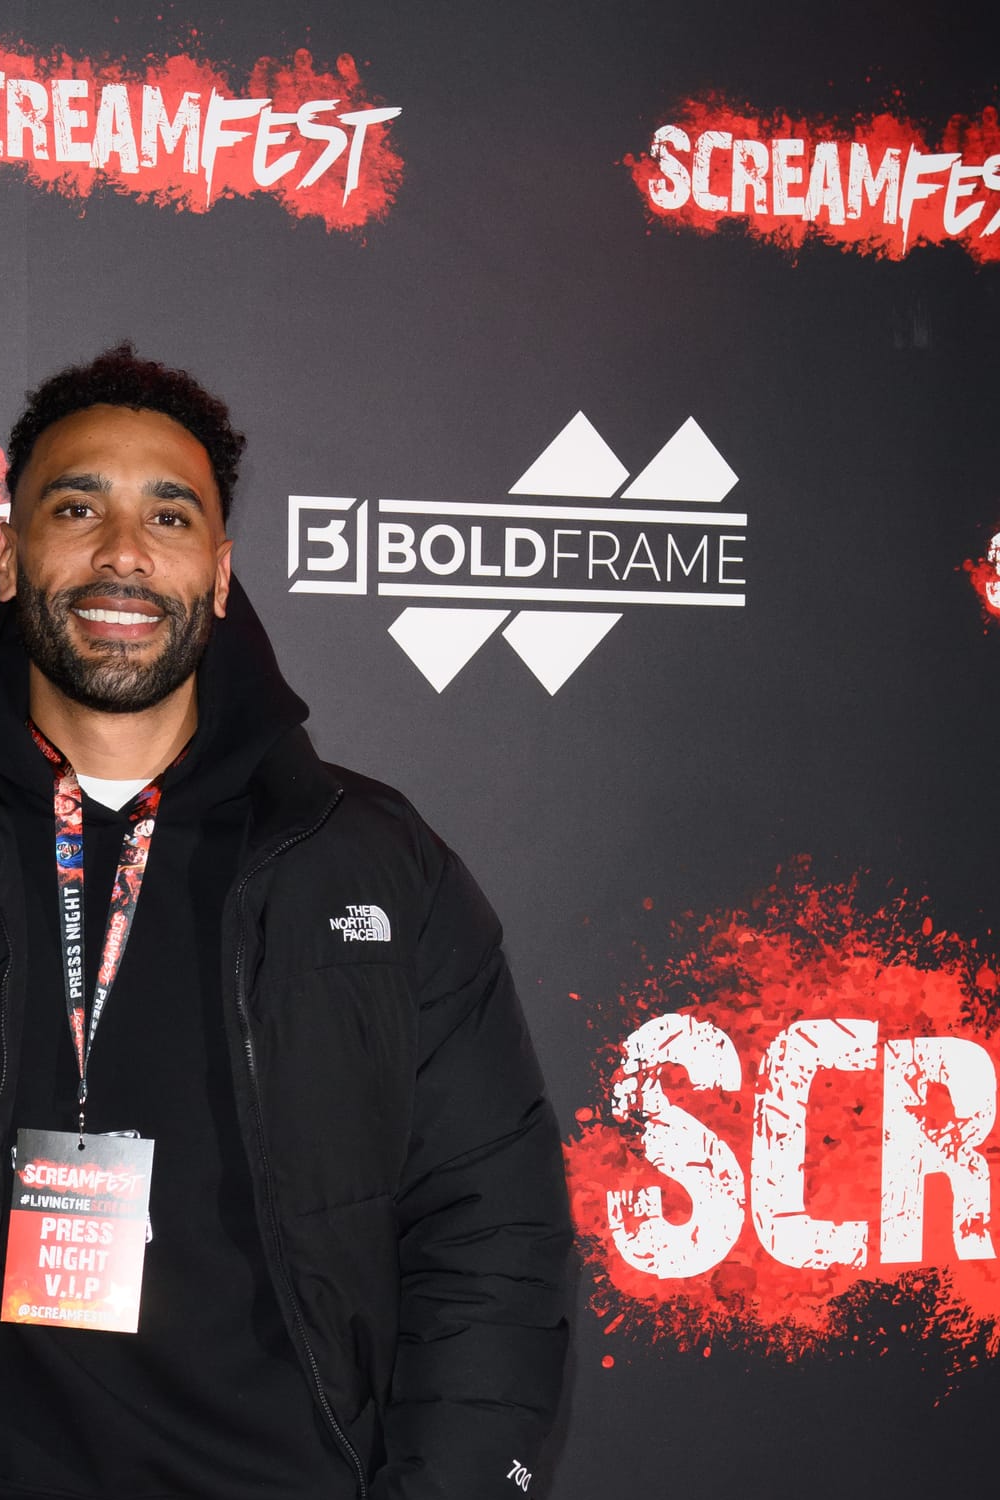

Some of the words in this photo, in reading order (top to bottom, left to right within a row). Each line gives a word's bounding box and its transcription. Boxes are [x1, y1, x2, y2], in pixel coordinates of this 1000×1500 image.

[377, 521, 747, 585] BOLDFRAME
[64, 887, 80, 940] NIGHT
[329, 917, 372, 931] NORTH
[345, 905, 371, 917] THE
[343, 929, 374, 942] FACE
[68, 946, 83, 999] PRESS
[606, 1012, 998, 1280] SCR
[23, 1164, 146, 1195] SCREAMFEST
[40, 1217, 115, 1245] PRESS
[39, 1244, 111, 1273] NIGHT
[45, 1273, 100, 1299] V.I.P
[506, 1459, 532, 1492] 700
